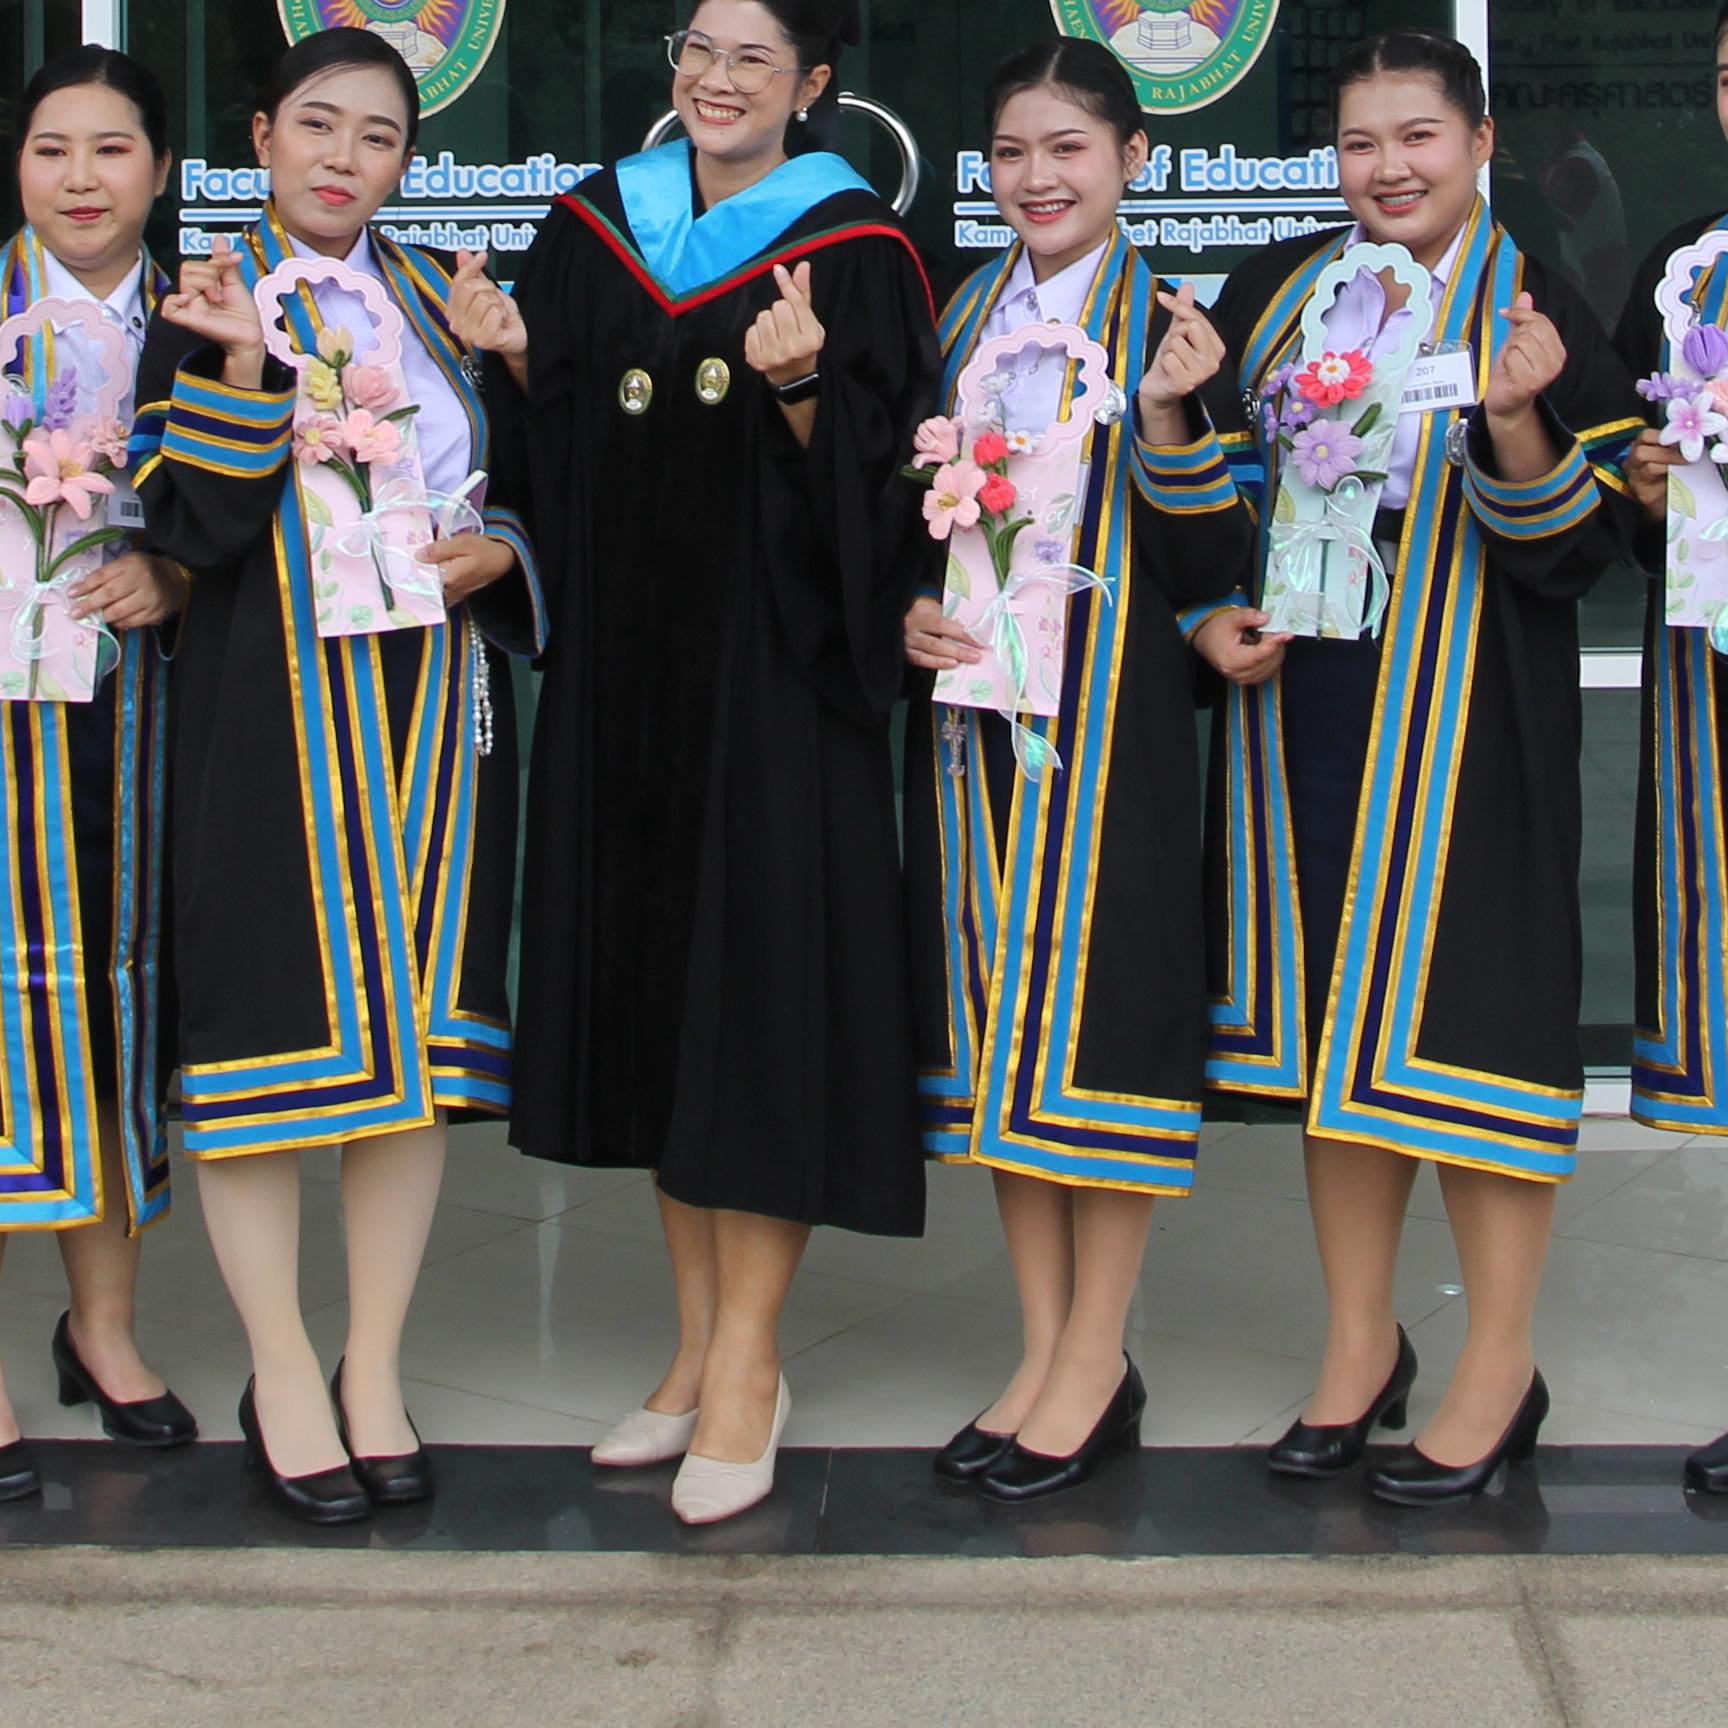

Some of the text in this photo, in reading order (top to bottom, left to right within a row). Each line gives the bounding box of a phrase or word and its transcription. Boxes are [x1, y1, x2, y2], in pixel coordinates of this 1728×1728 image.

[1152, 50, 1243, 103] RAJABHAT
[183, 160, 271, 198] Facu
[1128, 146, 1339, 191] of Educati
[1118, 218, 1156, 242] het
[1162, 217, 1269, 251] Rajabhat
